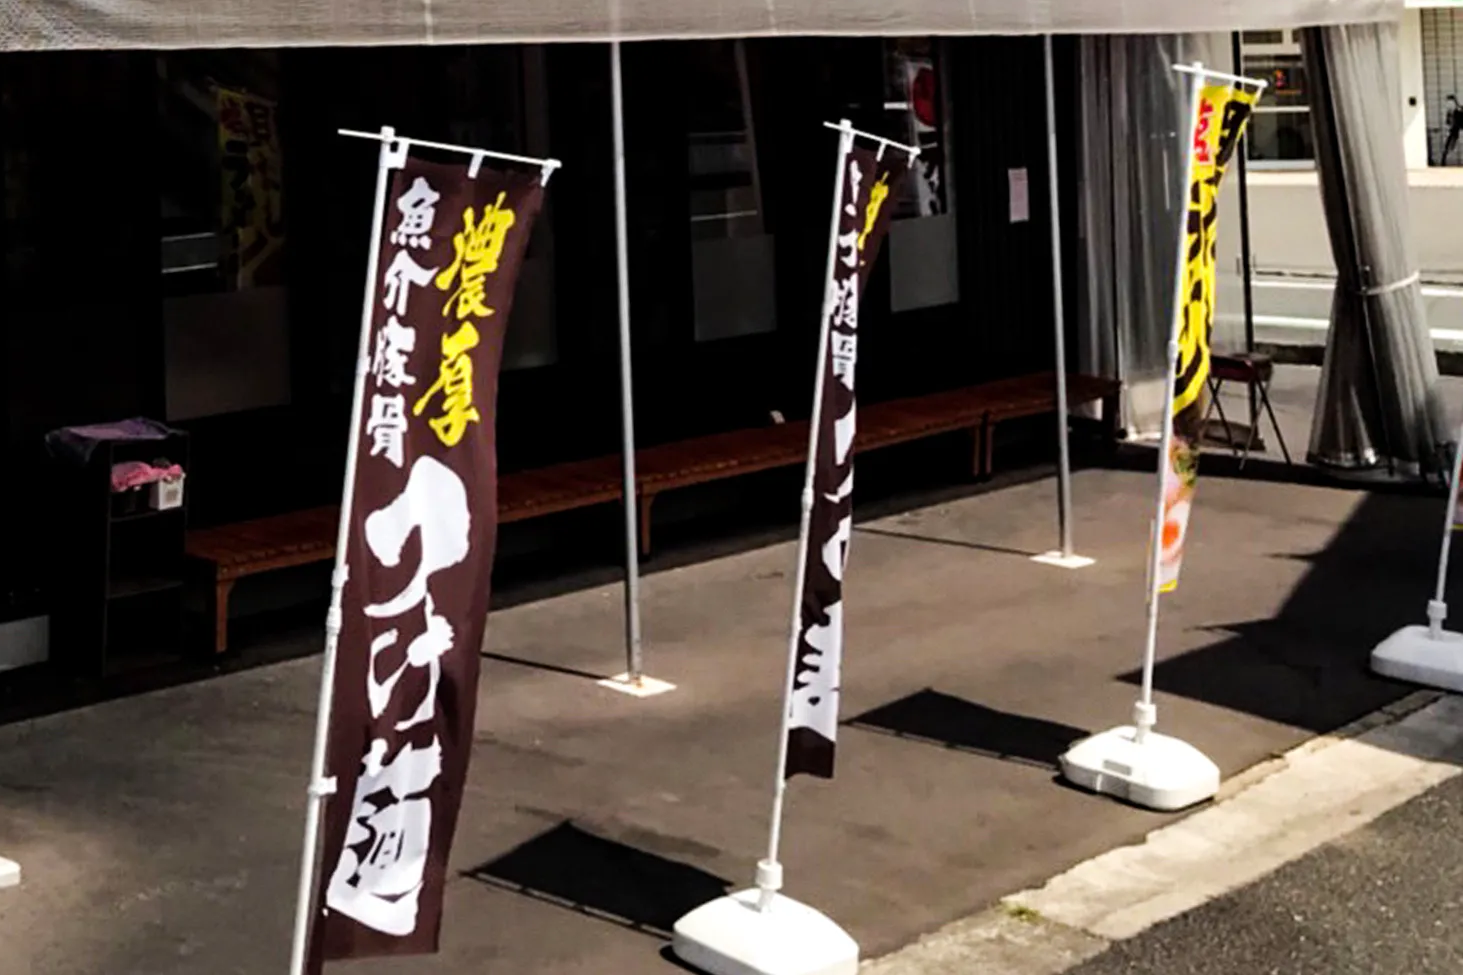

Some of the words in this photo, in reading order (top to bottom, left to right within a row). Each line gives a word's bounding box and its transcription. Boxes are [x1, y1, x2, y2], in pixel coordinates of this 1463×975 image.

[366, 177, 440, 468] 魚介豚骨
[412, 191, 515, 448] 濃厚
